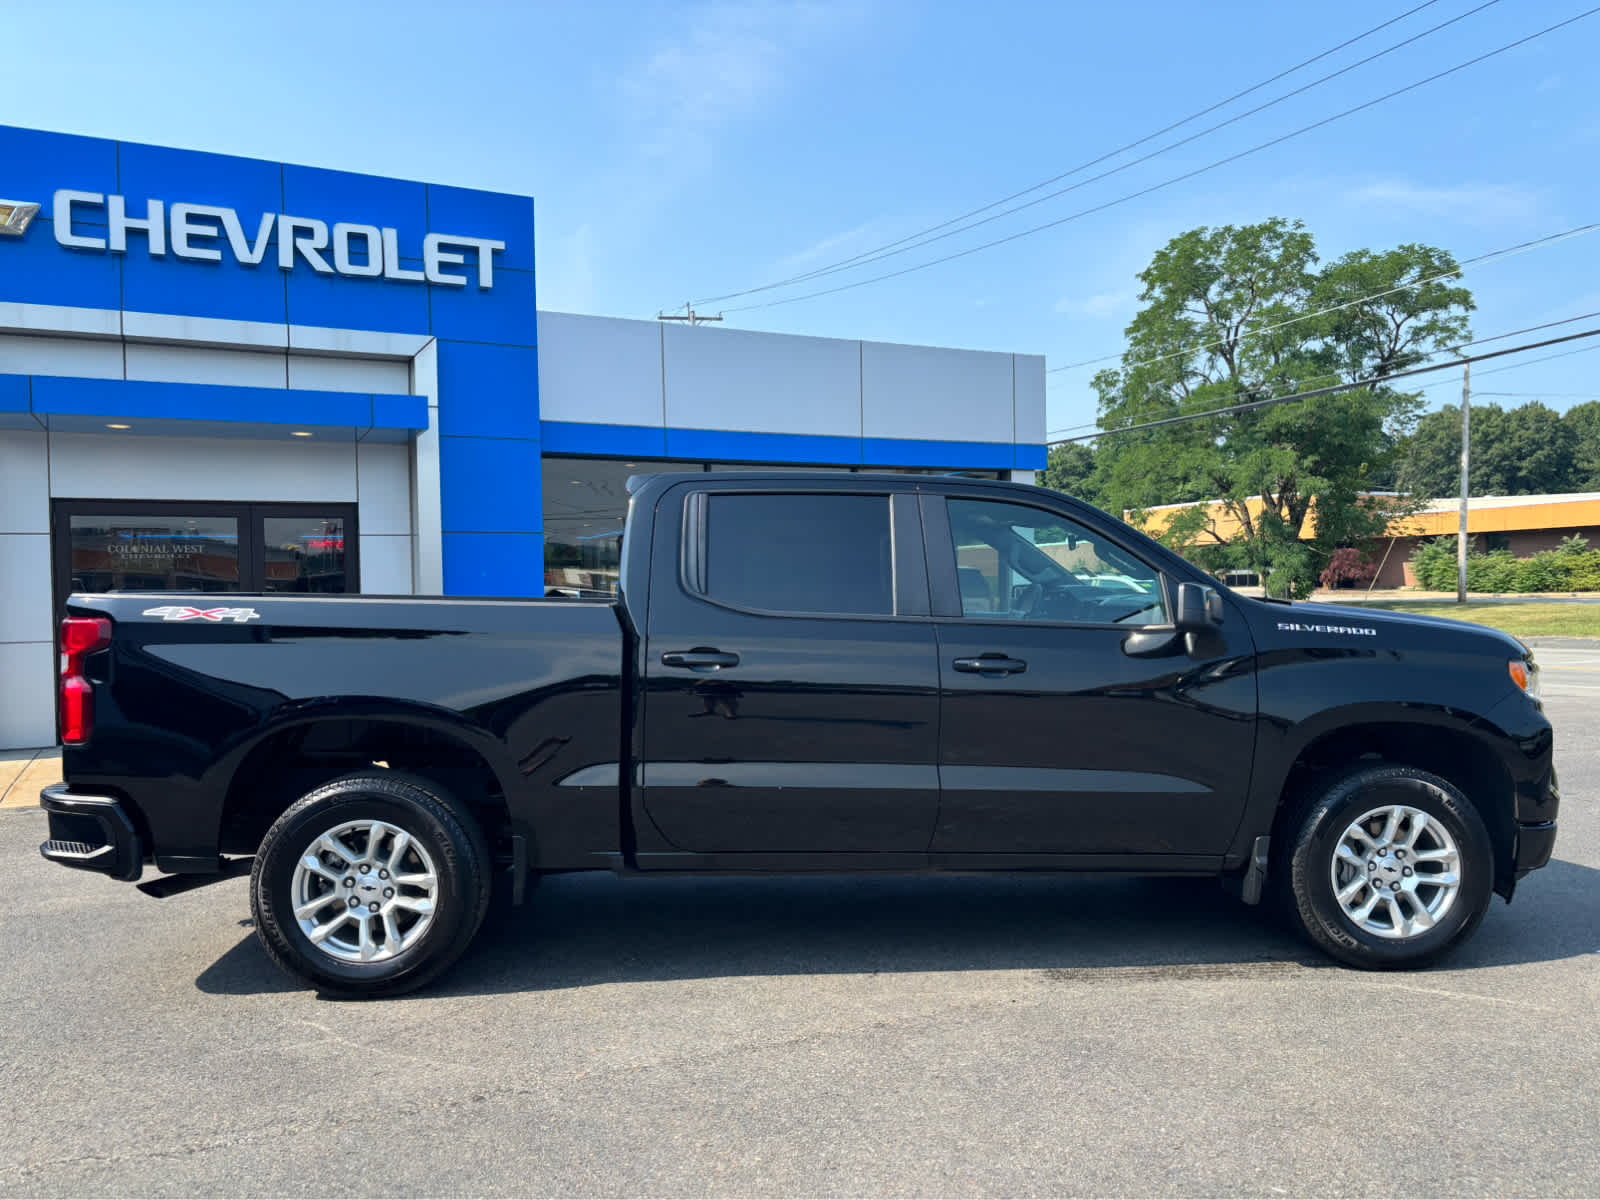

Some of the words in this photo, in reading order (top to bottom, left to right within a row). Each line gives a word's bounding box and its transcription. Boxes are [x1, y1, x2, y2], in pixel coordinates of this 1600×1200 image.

[53, 189, 506, 290] CHEVROLET
[172, 545, 204, 553] WEST
[1277, 623, 1377, 636] SILVERADO
